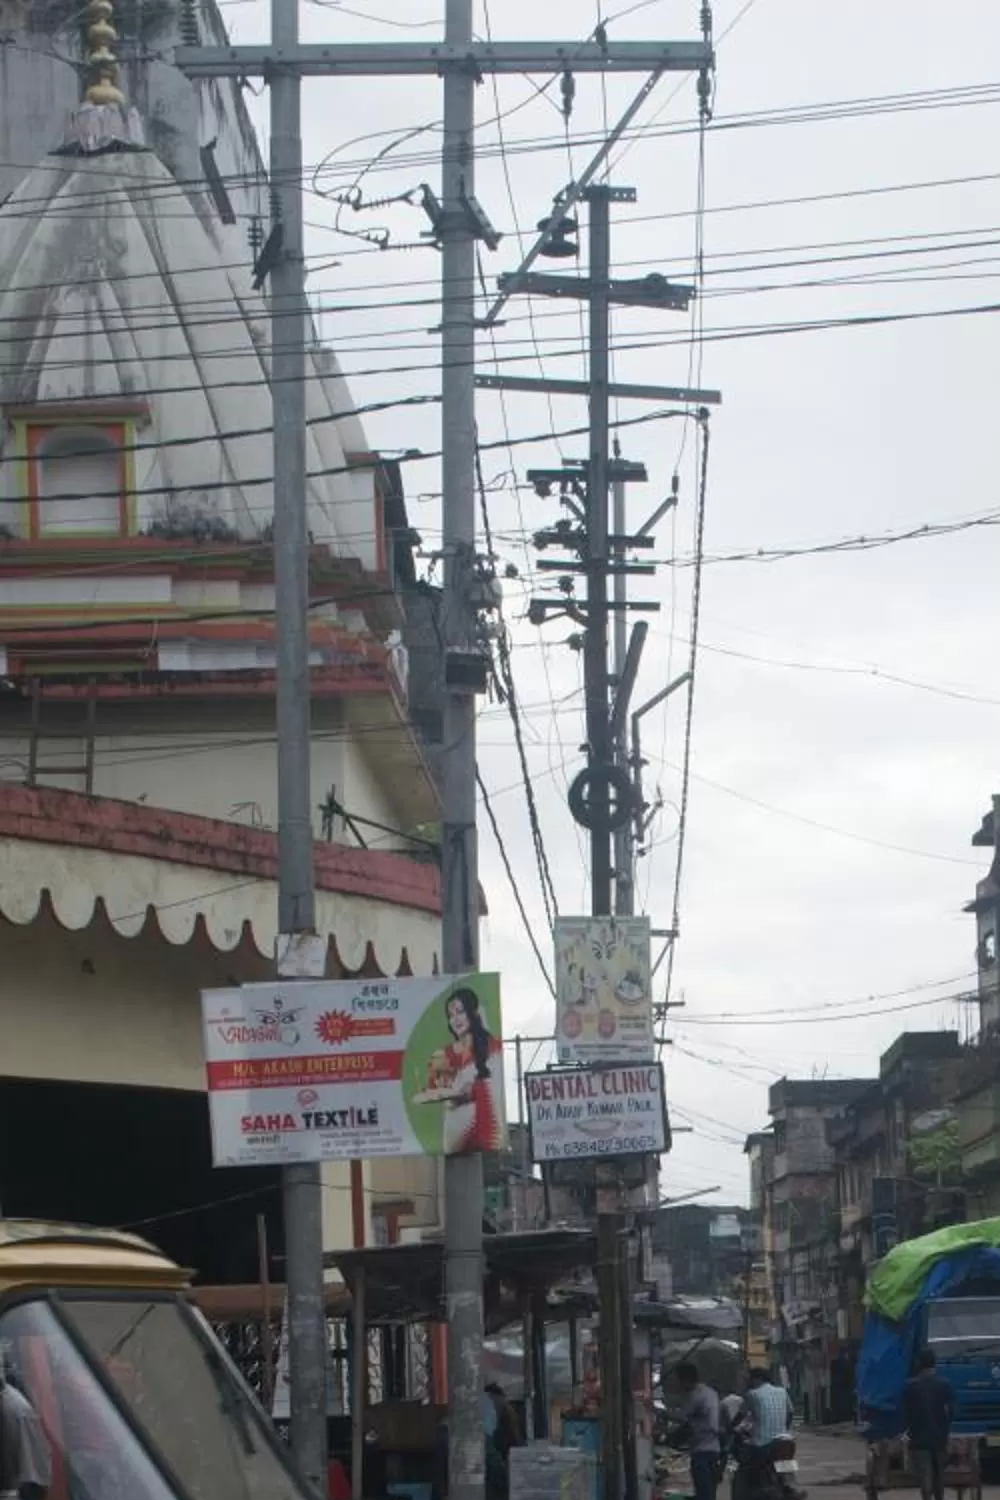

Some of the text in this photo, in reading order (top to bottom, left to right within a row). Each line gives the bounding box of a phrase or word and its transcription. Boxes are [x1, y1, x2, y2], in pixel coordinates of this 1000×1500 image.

[530, 1069, 657, 1101] DENTAL CLINIC
[240, 1106, 379, 1132] SAHA TEXTILE
